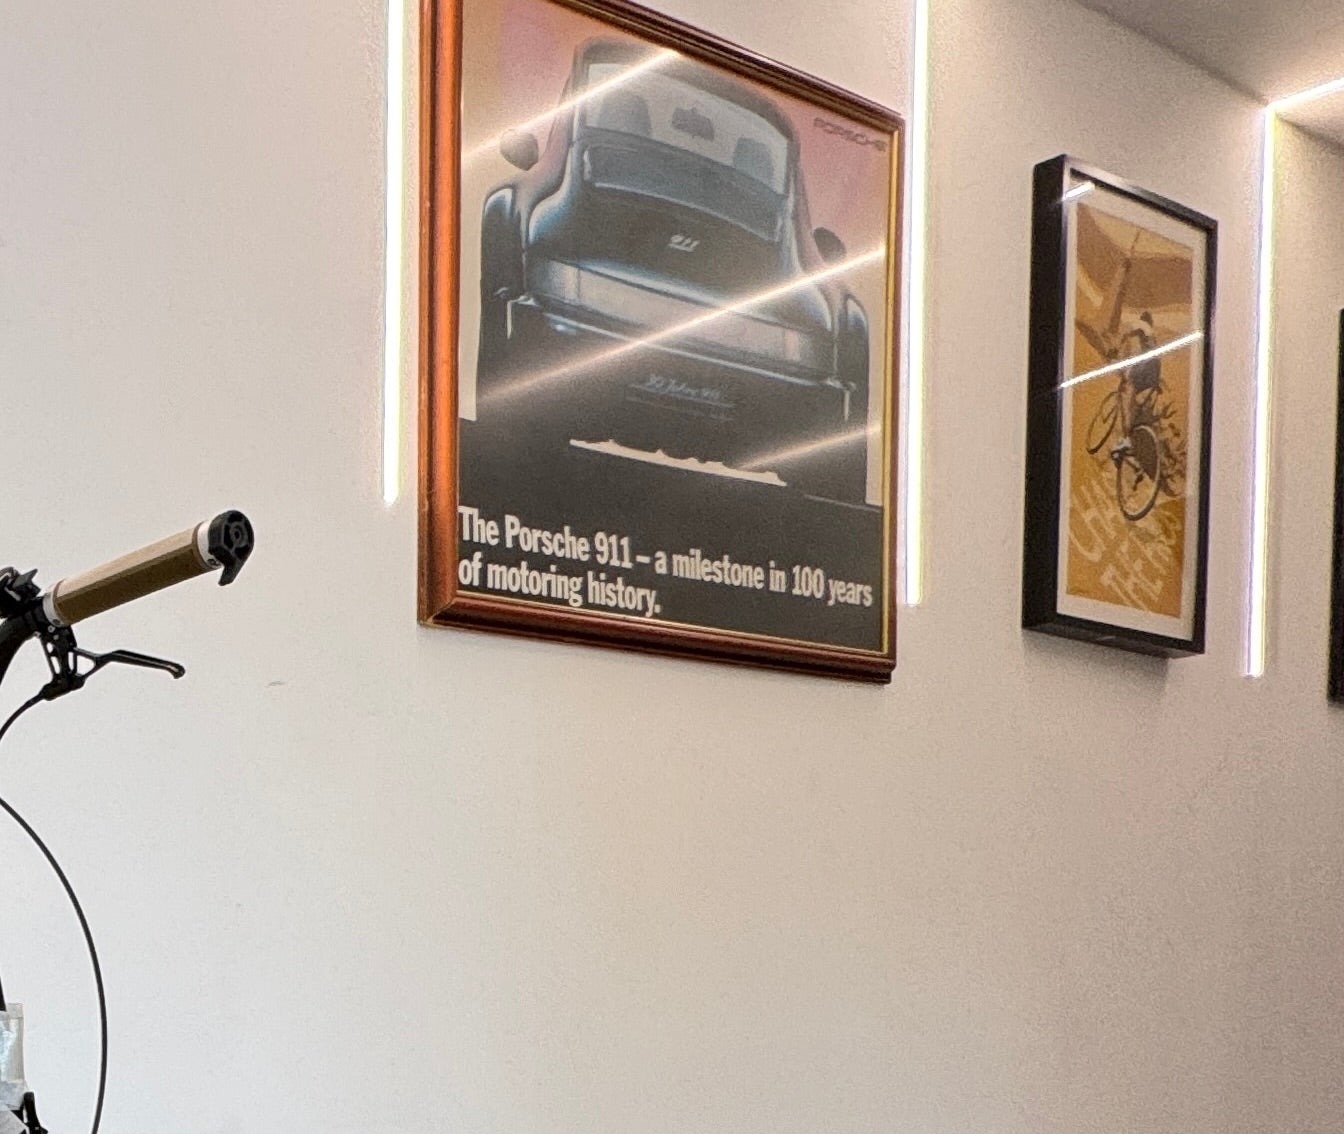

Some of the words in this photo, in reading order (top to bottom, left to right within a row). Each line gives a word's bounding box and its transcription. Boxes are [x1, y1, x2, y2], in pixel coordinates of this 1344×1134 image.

[457, 504, 499, 547] The
[504, 514, 590, 562] Porsche
[594, 530, 633, 569] 911
[654, 551, 668, 575] a
[672, 547, 765, 590] milestone
[769, 560, 786, 593] in
[792, 565, 825, 599] 100
[827, 577, 873, 608] years
[458, 552, 484, 586] of
[487, 560, 583, 608] motoring
[587, 570, 661, 617] history.
